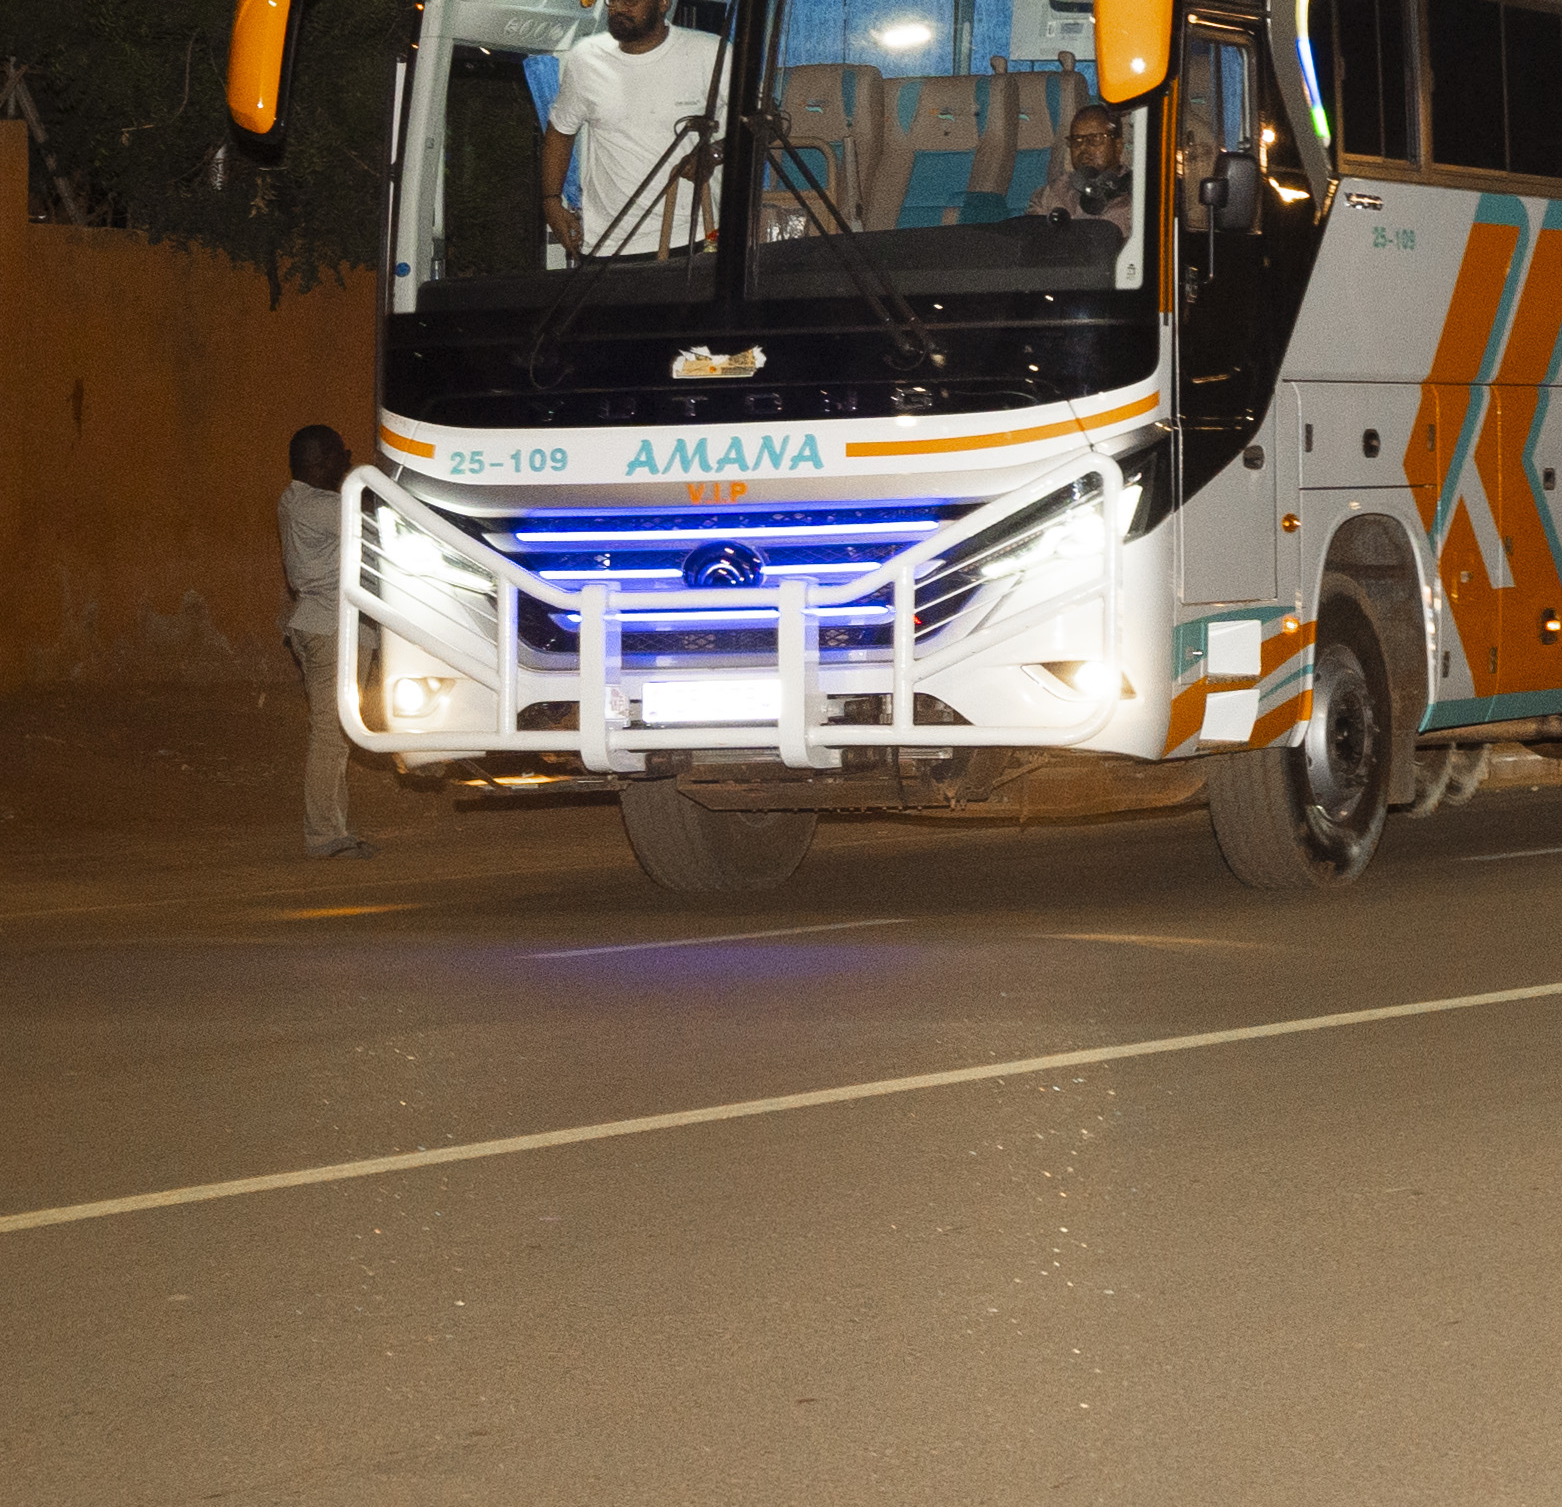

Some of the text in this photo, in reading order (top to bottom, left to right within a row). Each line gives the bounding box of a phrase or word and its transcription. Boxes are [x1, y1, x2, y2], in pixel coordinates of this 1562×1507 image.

[450, 447, 569, 476] 25-109
[625, 433, 825, 476] AMANA
[686, 482, 748, 505] V.I.P
